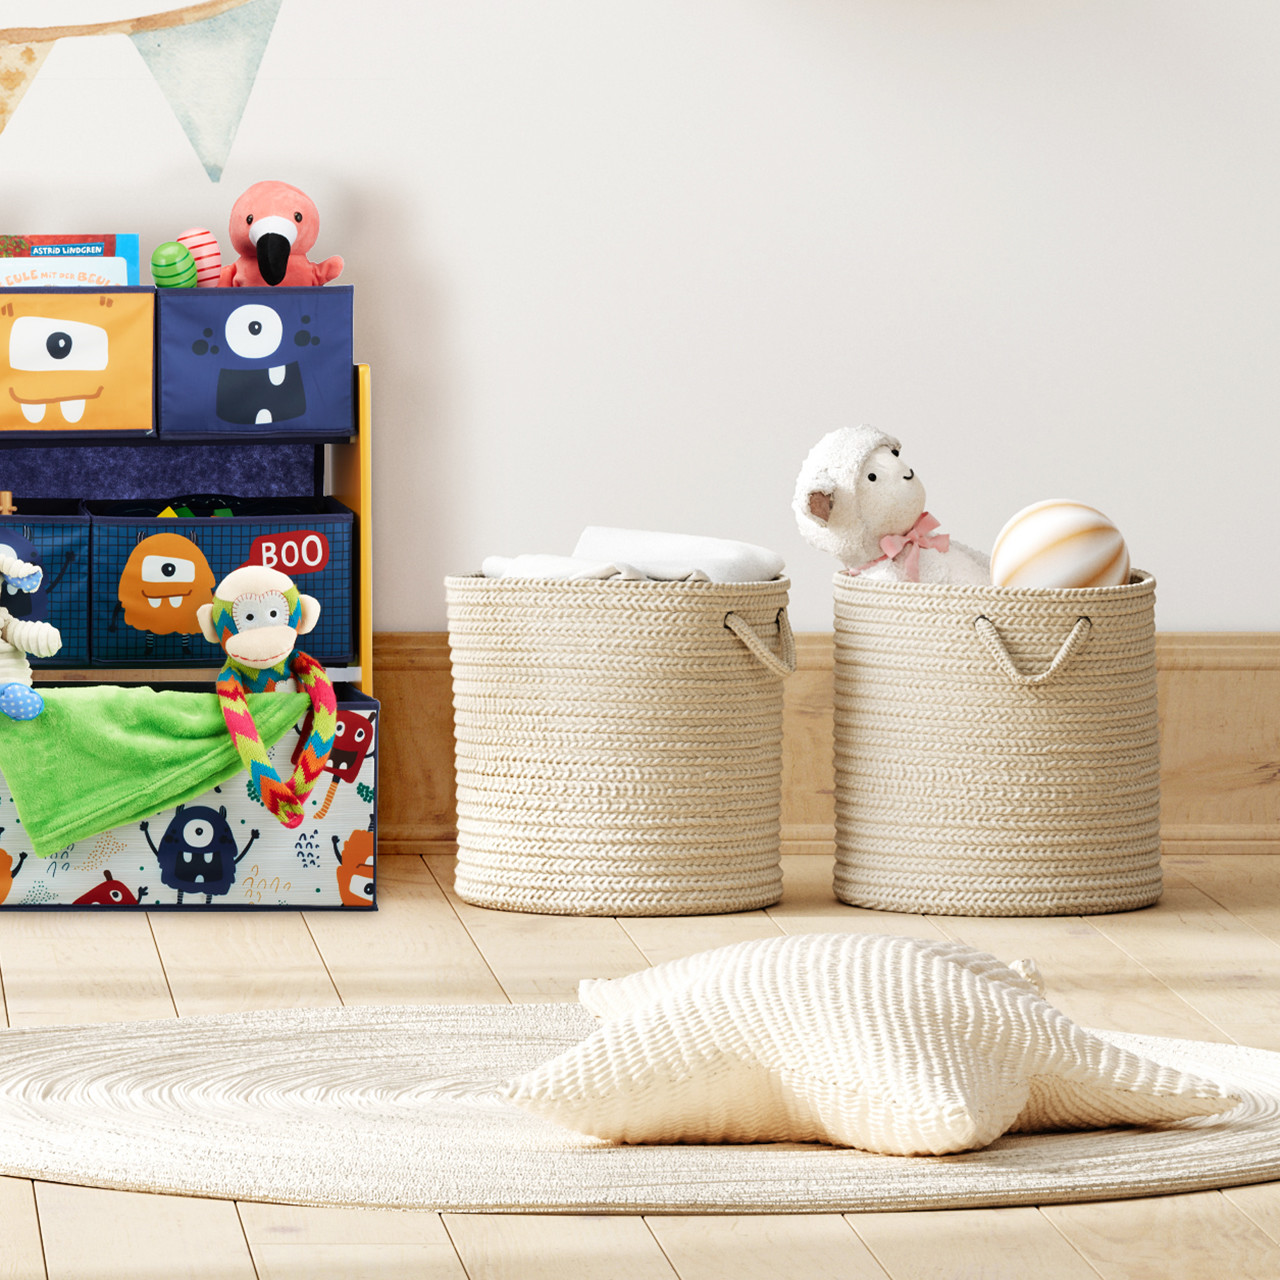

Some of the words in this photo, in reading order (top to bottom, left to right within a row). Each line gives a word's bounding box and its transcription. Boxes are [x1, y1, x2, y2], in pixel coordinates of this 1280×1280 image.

[5, 269, 39, 286] EULE
[59, 272, 75, 280] DER
[261, 534, 323, 568] BOO
